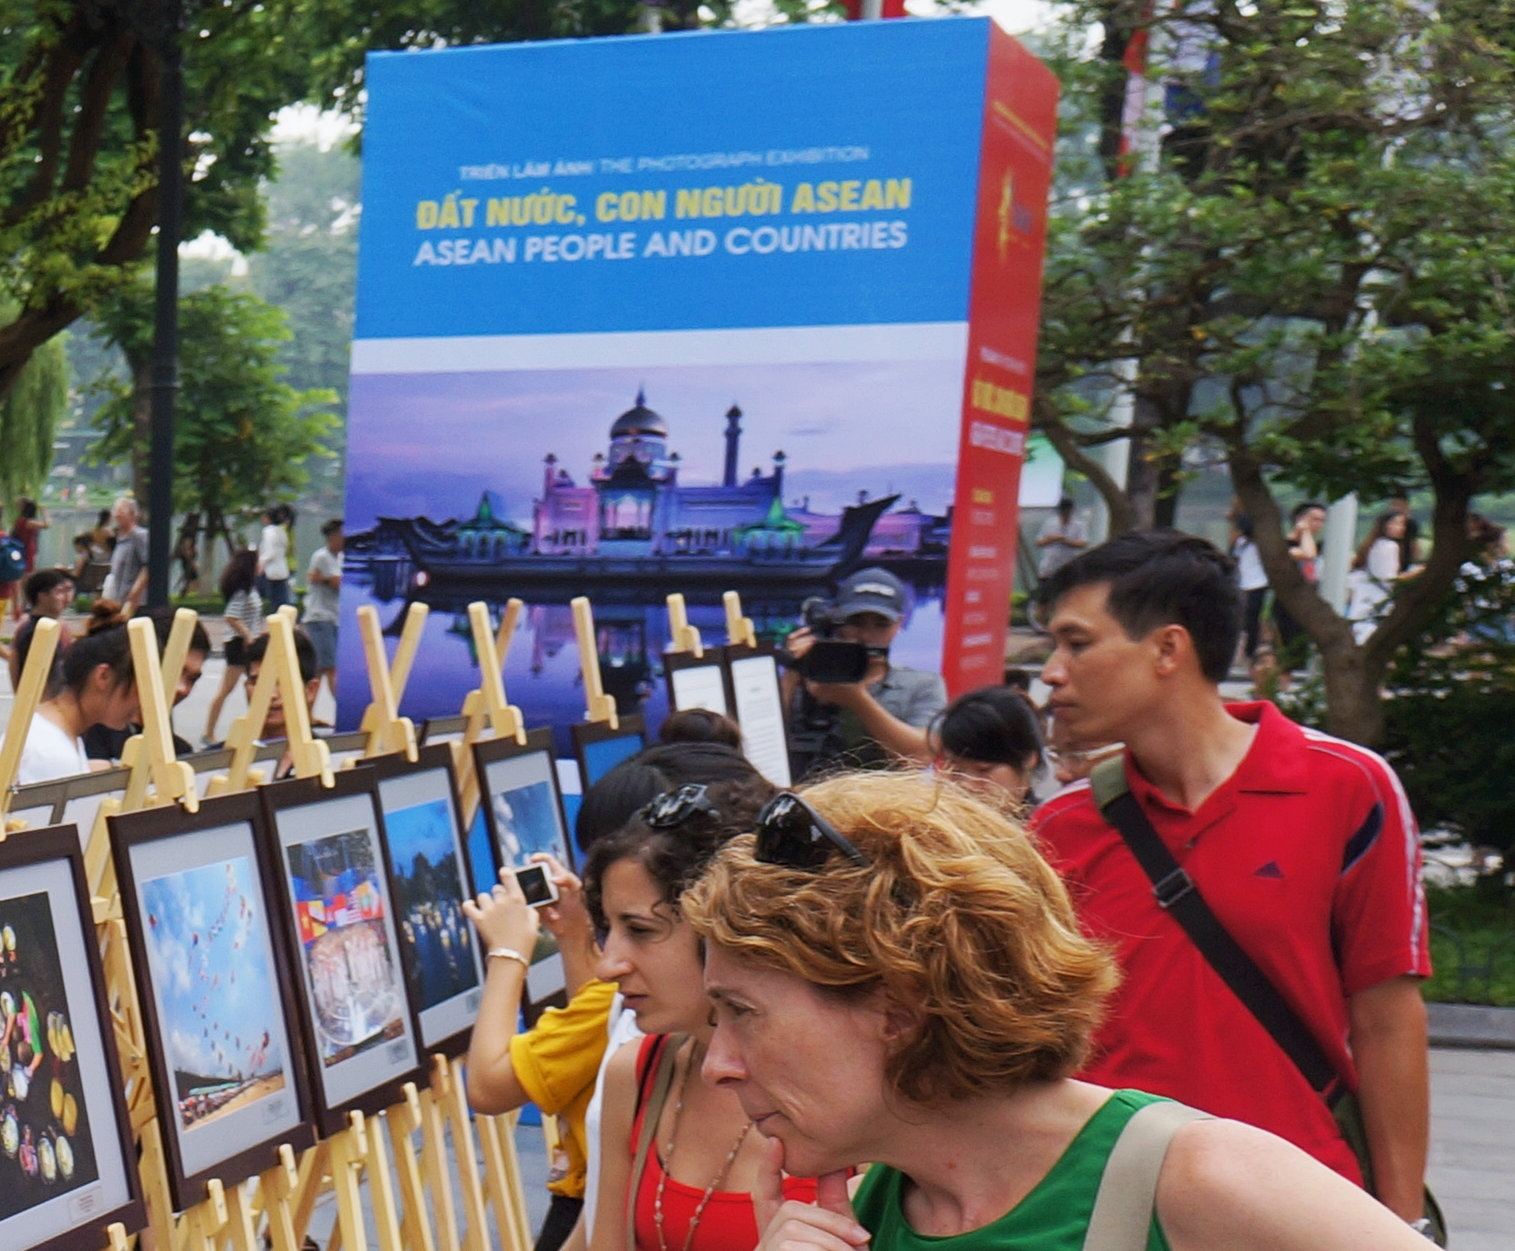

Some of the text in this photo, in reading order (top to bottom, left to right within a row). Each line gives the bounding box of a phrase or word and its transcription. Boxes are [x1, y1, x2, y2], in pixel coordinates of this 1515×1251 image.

[415, 177, 912, 230] ĐẤT NƯỚC, CON NGƯỜI ASEAN
[413, 220, 908, 266] ASEAN PEOPLE AND COUNTRIES
